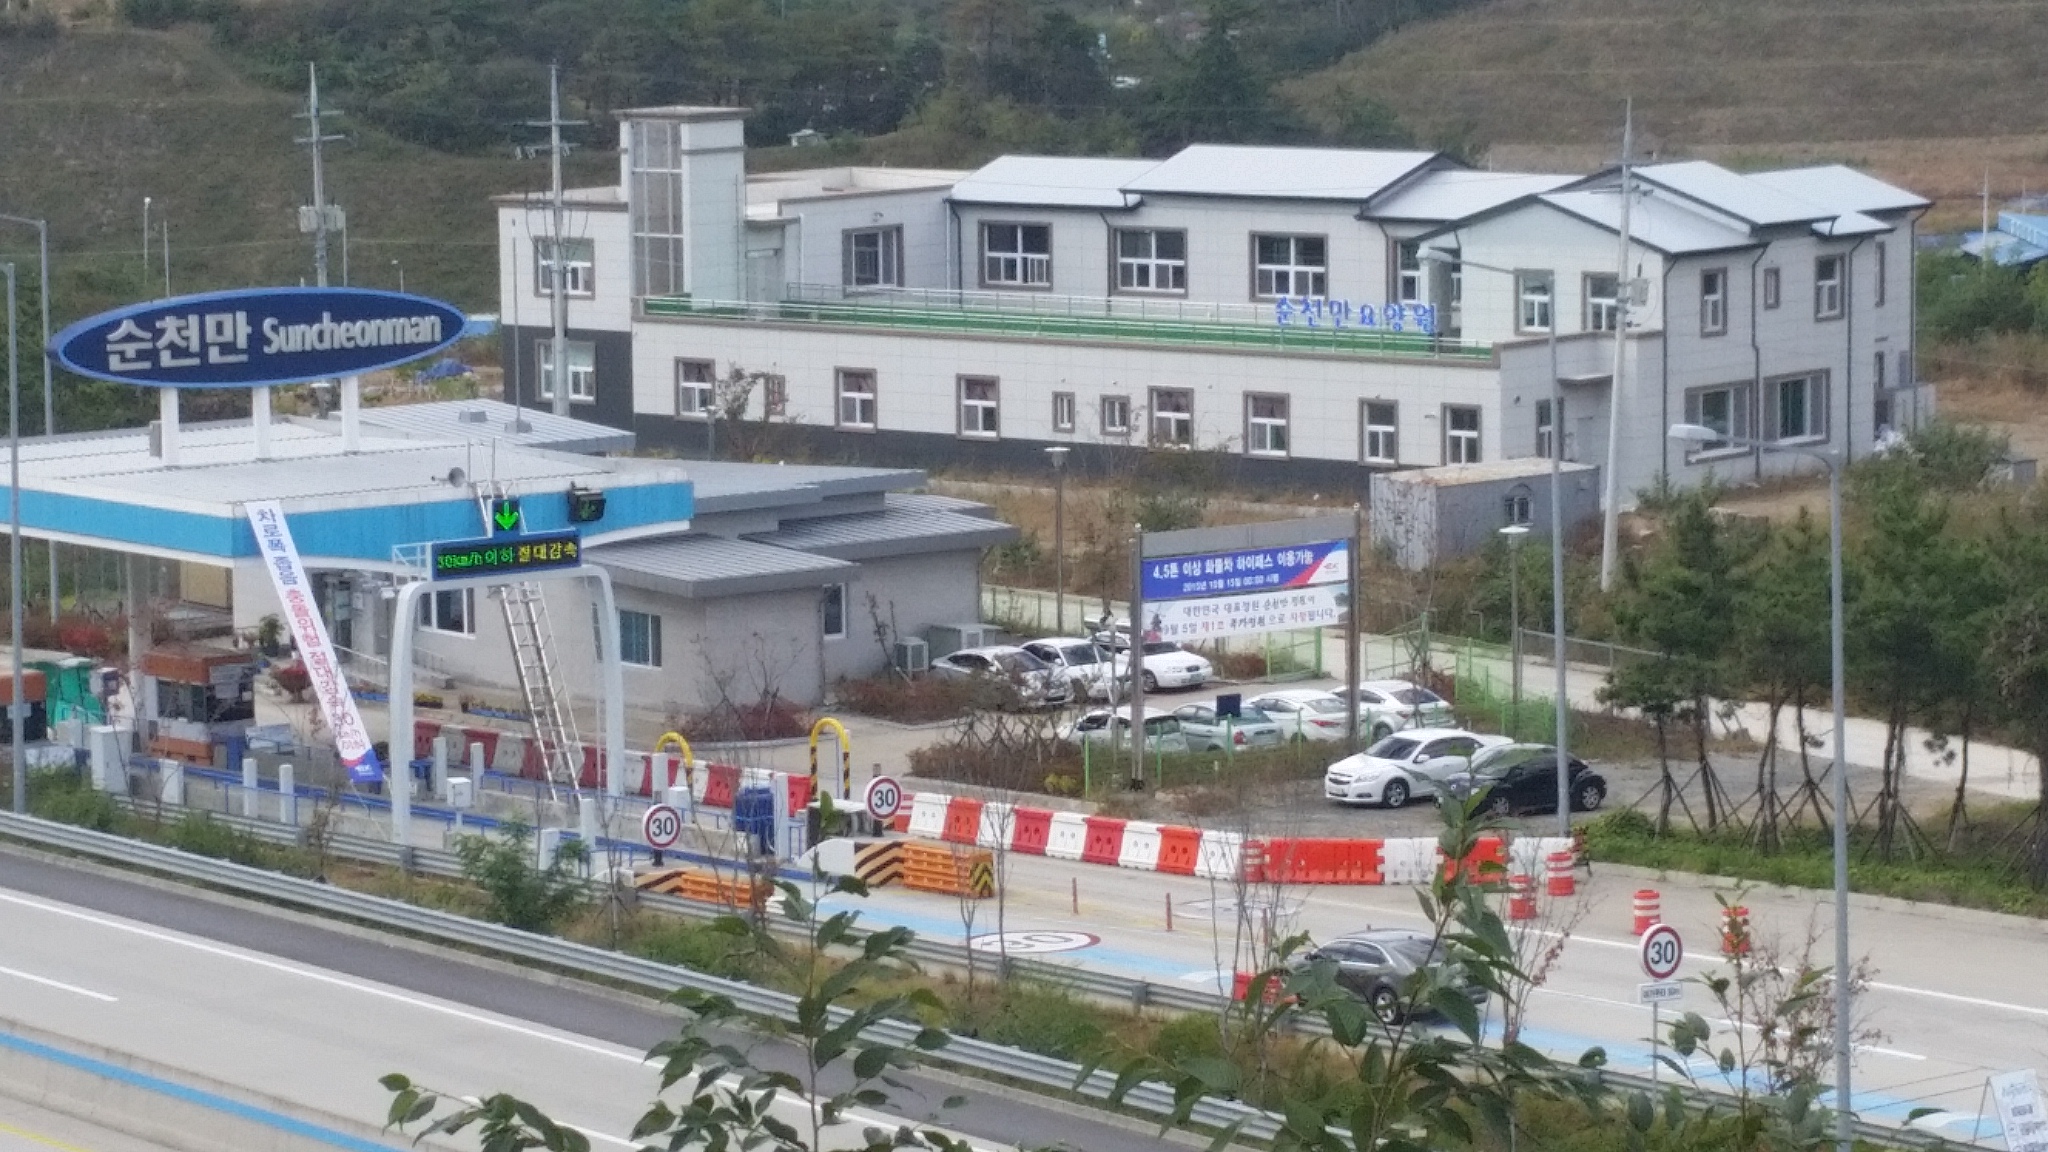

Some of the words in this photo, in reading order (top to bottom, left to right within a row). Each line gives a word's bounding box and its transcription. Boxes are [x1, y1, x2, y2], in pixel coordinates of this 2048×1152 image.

[106, 311, 251, 372] 순천만
[263, 311, 441, 354] Suncheonman
[519, 541, 578, 563] 절대감속
[1153, 562, 1179, 579] 4.5톤
[1182, 560, 1202, 577] 이상
[1205, 557, 1233, 574] 화물차
[1236, 553, 1274, 571] 하이패스
[1277, 549, 1313, 567] 이용가능
[1183, 603, 1219, 617] 대한민국
[874, 788, 895, 808] 30
[652, 817, 674, 837] 30
[1650, 939, 1676, 965] 30
